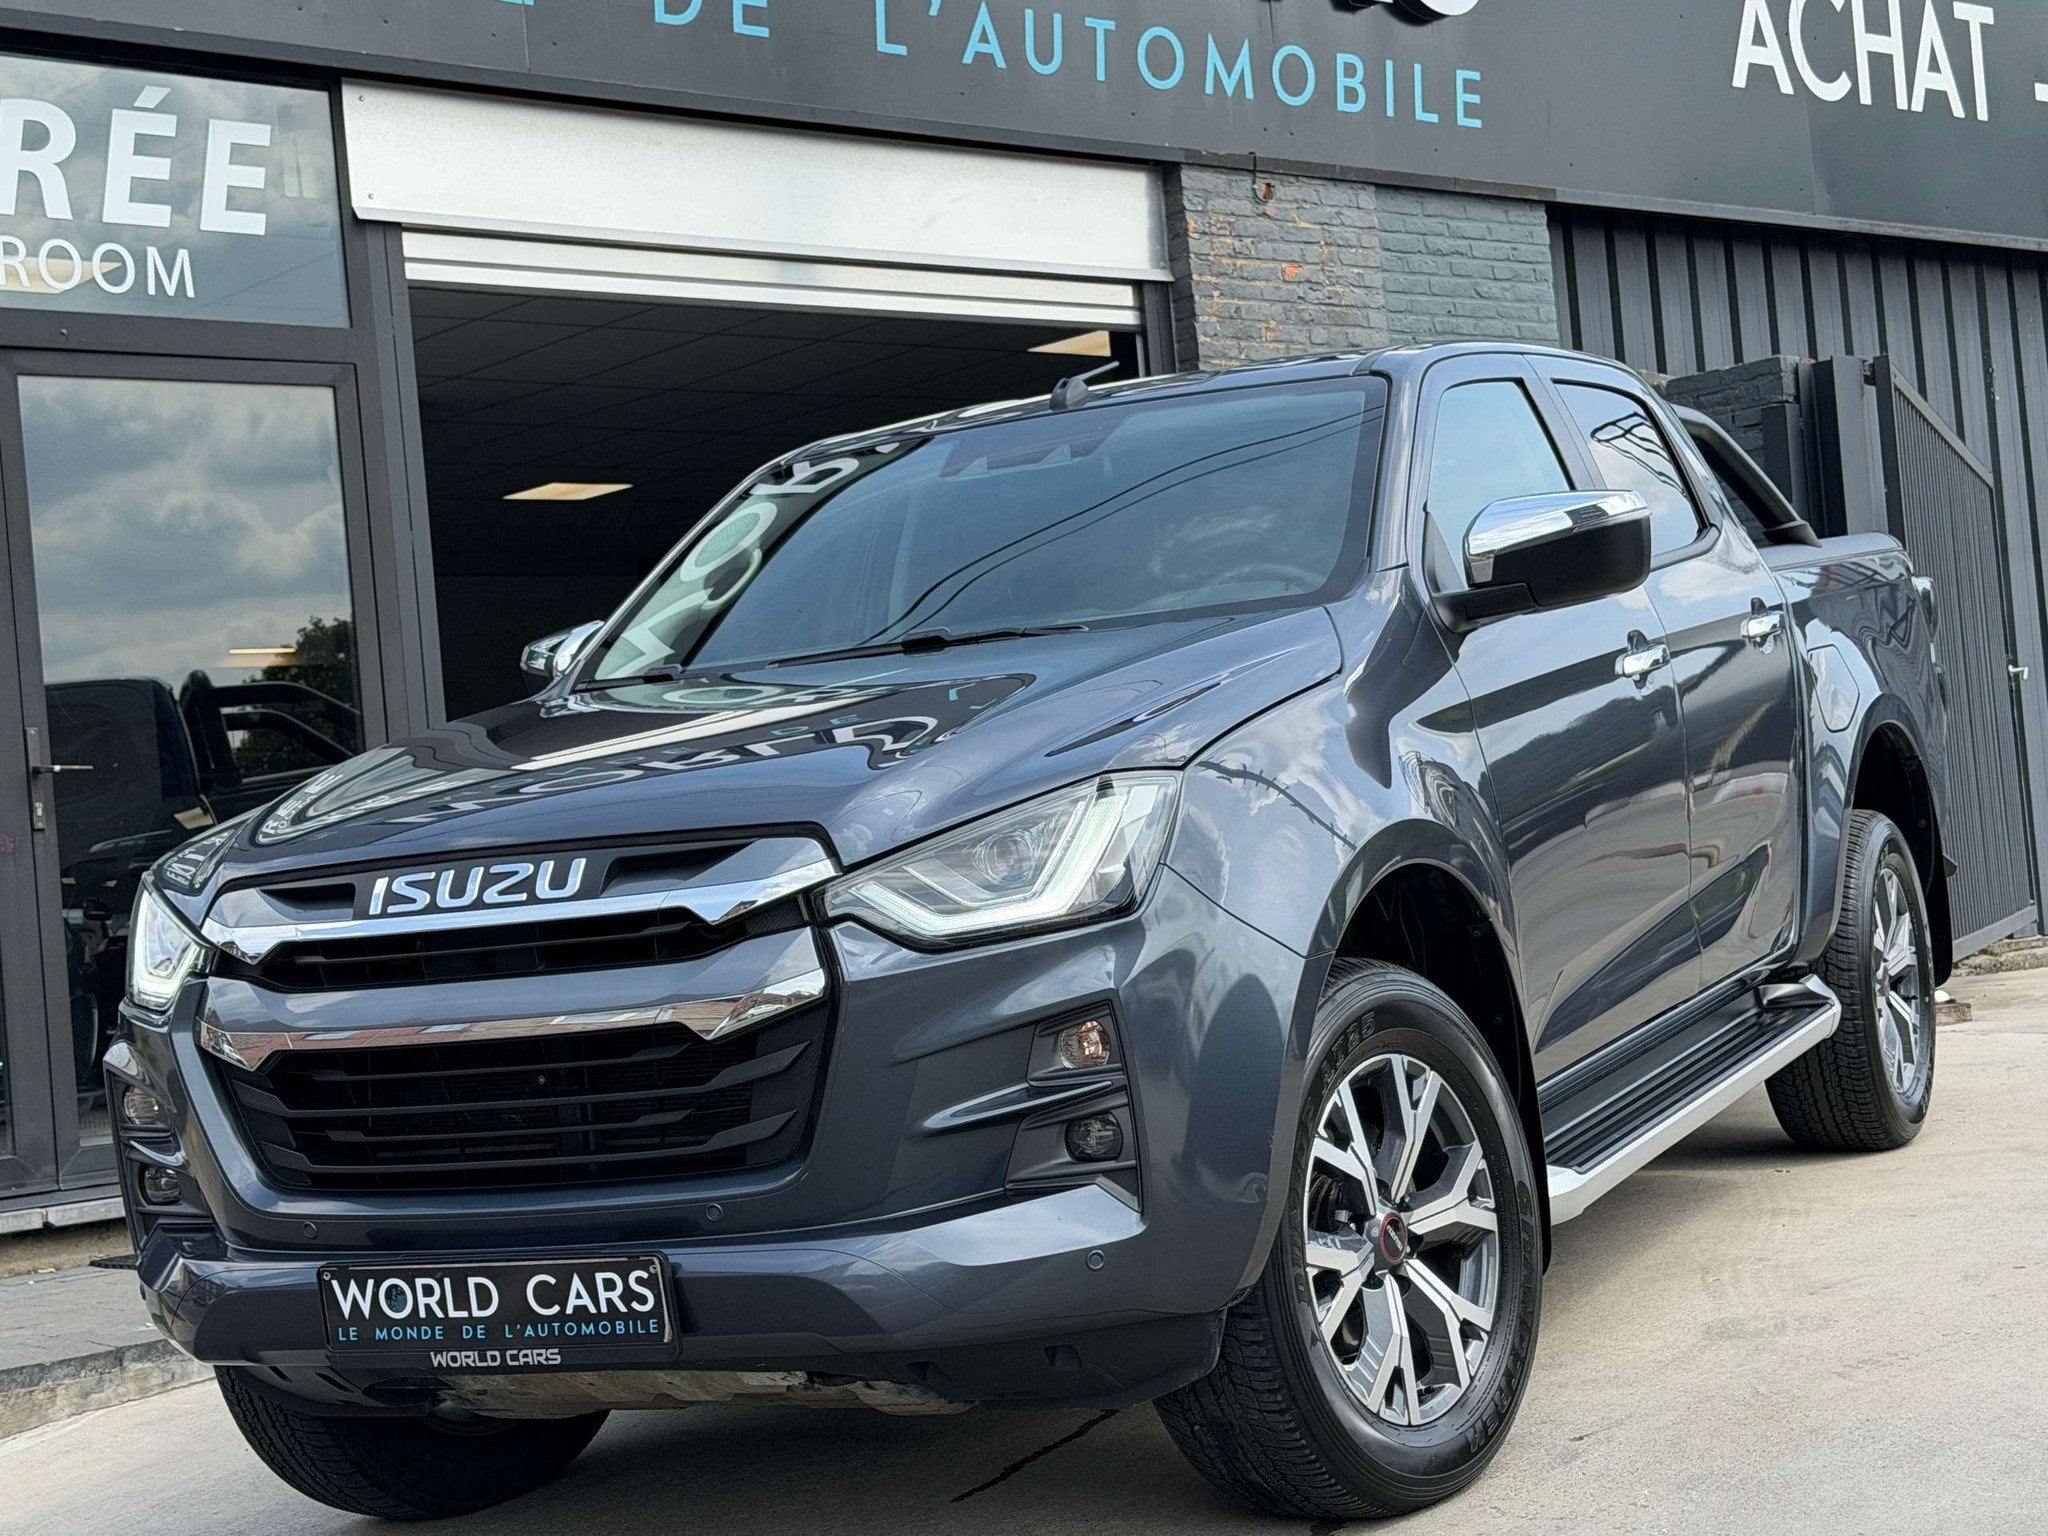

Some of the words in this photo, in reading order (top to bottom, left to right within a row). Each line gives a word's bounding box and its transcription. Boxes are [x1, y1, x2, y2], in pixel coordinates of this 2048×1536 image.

[1731, 0, 1995, 122] ACHAT
[0, 235, 196, 299] ROOM
[368, 857, 587, 916] ISUZU
[330, 1275, 500, 1321] WORLD
[525, 1269, 656, 1316] CARS
[337, 1326, 360, 1342] LE
[375, 1325, 445, 1341] MONDE
[462, 1324, 487, 1340] DE
[504, 1318, 659, 1339] L'AUTOMOBILE
[429, 1350, 501, 1368] WORLD
[505, 1348, 562, 1367] CARS
